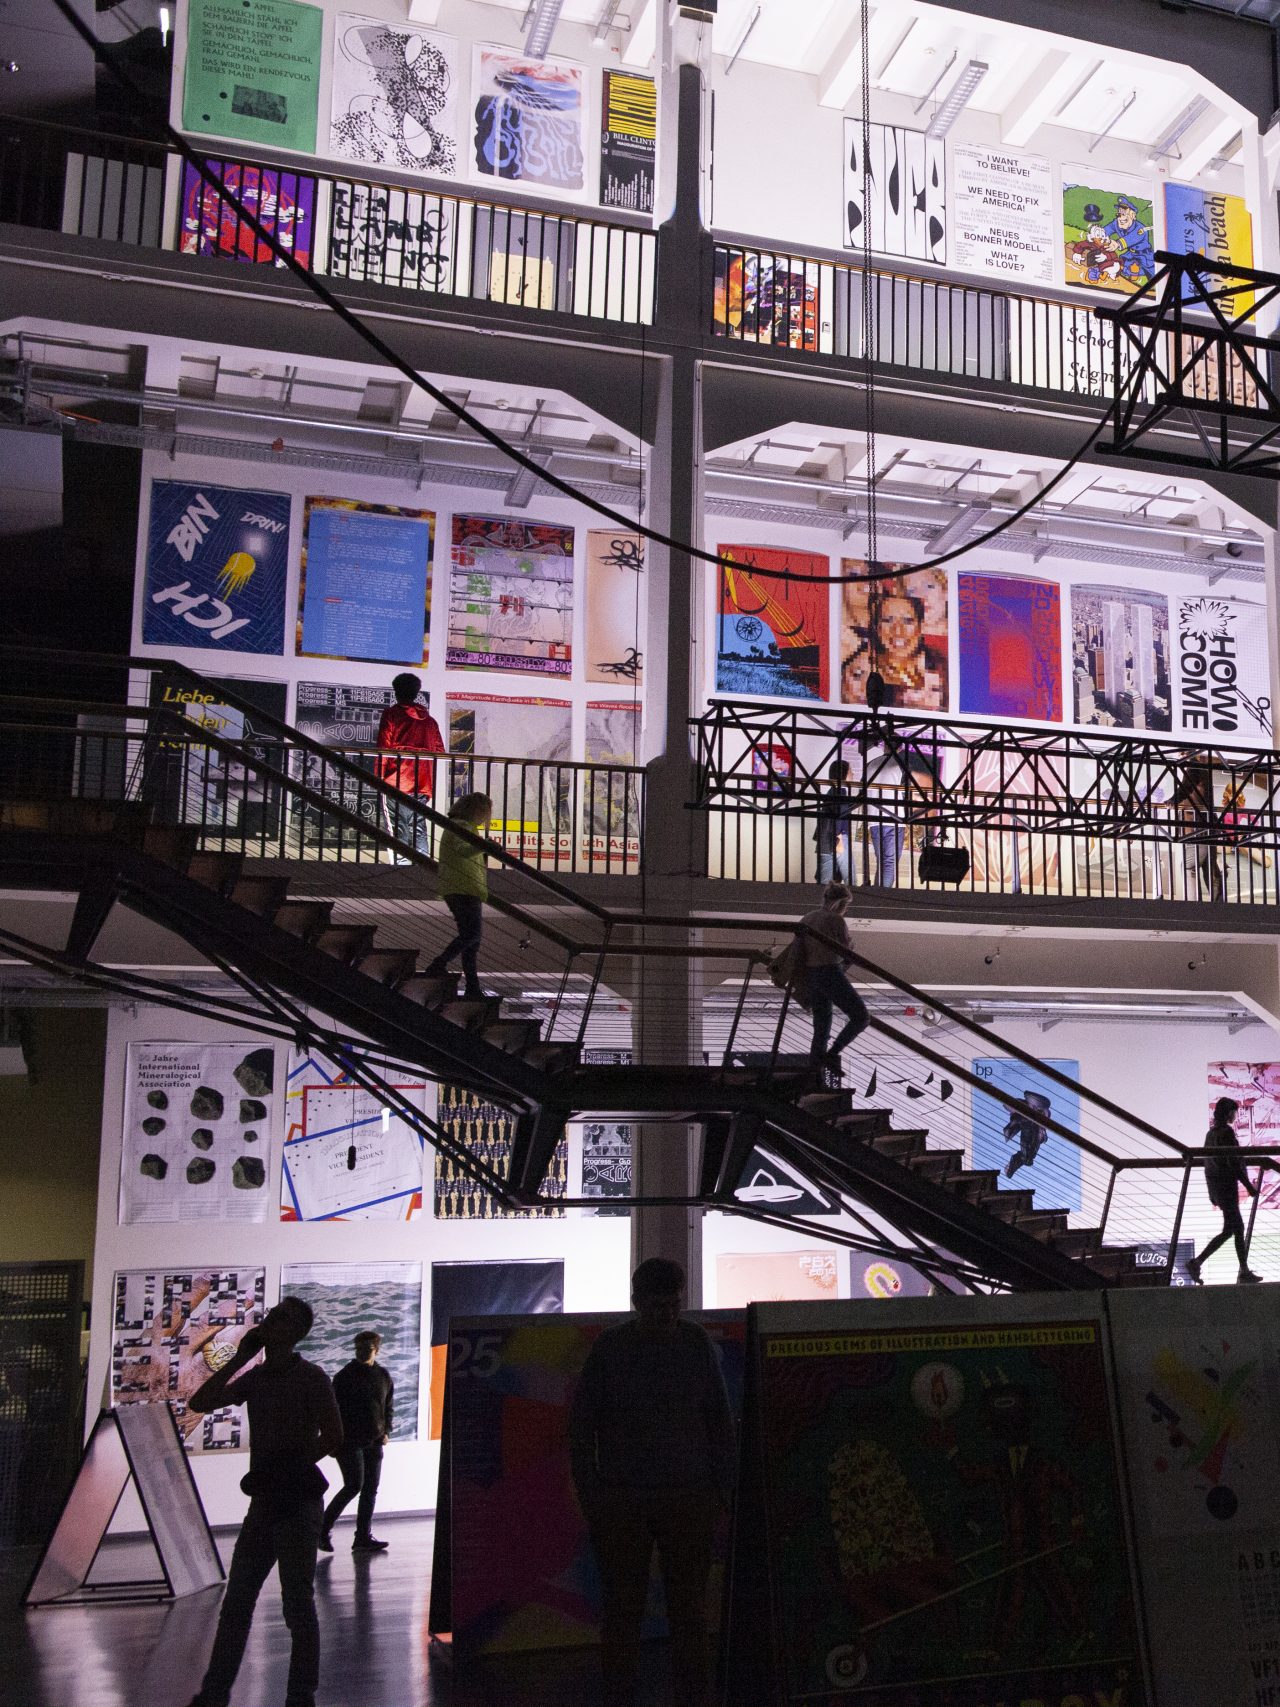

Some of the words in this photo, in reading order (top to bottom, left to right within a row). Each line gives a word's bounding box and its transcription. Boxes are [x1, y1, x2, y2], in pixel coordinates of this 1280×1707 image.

[613, 132, 630, 141] BILL
[976, 160, 989, 169] TO
[990, 163, 1030, 178] BELIEVE!
[992, 155, 1019, 167] WANT
[968, 186, 983, 195] WE
[985, 188, 1010, 200] NEED
[1012, 194, 1024, 203] TO
[1025, 198, 1040, 207] FIX
[982, 196, 1026, 213] AMERICA!
[1204, 196, 1230, 250] beach
[964, 232, 1002, 246] BONNER
[989, 227, 1020, 241] NEUES
[990, 250, 1019, 262] WHAT
[985, 258, 994, 267] IS
[996, 259, 1025, 272] LOVE?
[166, 492, 220, 562] BIN
[152, 581, 251, 640] ICH
[1180, 631, 1209, 730] COME
[1210, 634, 1238, 721] HOW
[162, 686, 214, 705] Liebe
[138, 1063, 200, 1072] International
[152, 1054, 179, 1064] Jahre
[138, 1072, 201, 1082] Mineralogical
[975, 1062, 994, 1078] bp
[137, 1081, 191, 1089] Association
[770, 1341, 831, 1355] PRECIOUS
[833, 1340, 867, 1352] GEMS
[870, 1338, 884, 1350] OF
[886, 1335, 970, 1350] ILLUSTRATION
[971, 1334, 995, 1346] AND
[997, 1330, 1092, 1346] HANDLETTERING
[450, 1335, 502, 1378] 25
[1250, 1658, 1280, 1679] VF1
